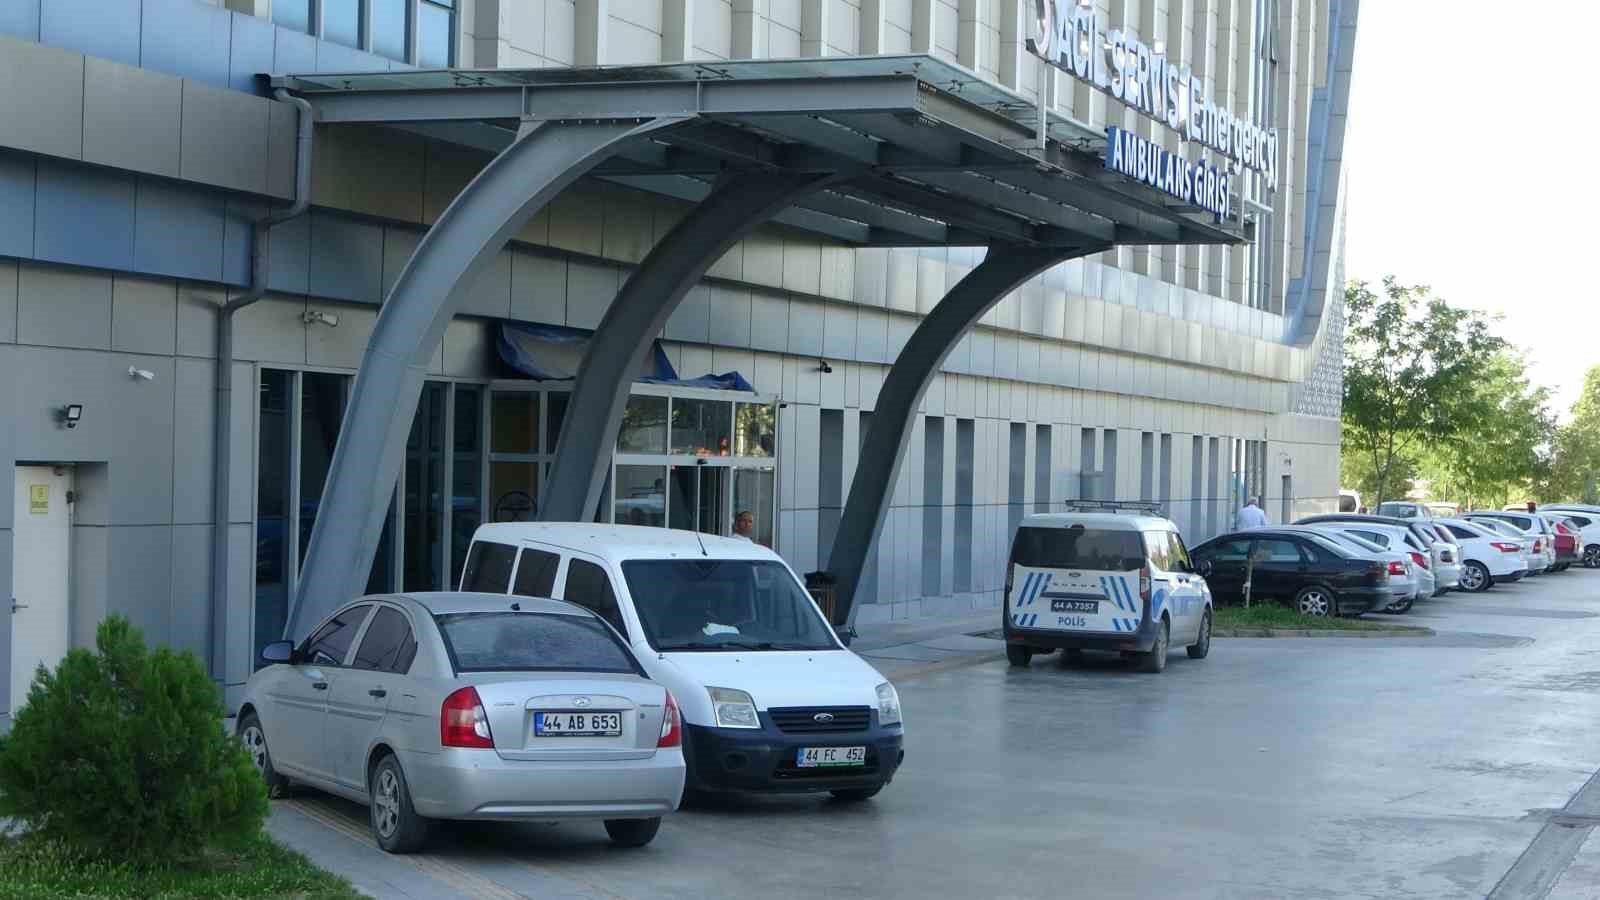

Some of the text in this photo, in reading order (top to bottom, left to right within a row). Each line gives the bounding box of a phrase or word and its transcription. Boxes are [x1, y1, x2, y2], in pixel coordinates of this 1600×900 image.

[1112, 127, 1192, 202] AMBULANS
[1058, 616, 1086, 627] POLİS
[544, 715, 618, 730] 44 AB 653
[806, 748, 818, 761] 44
[846, 747, 864, 761] 452
